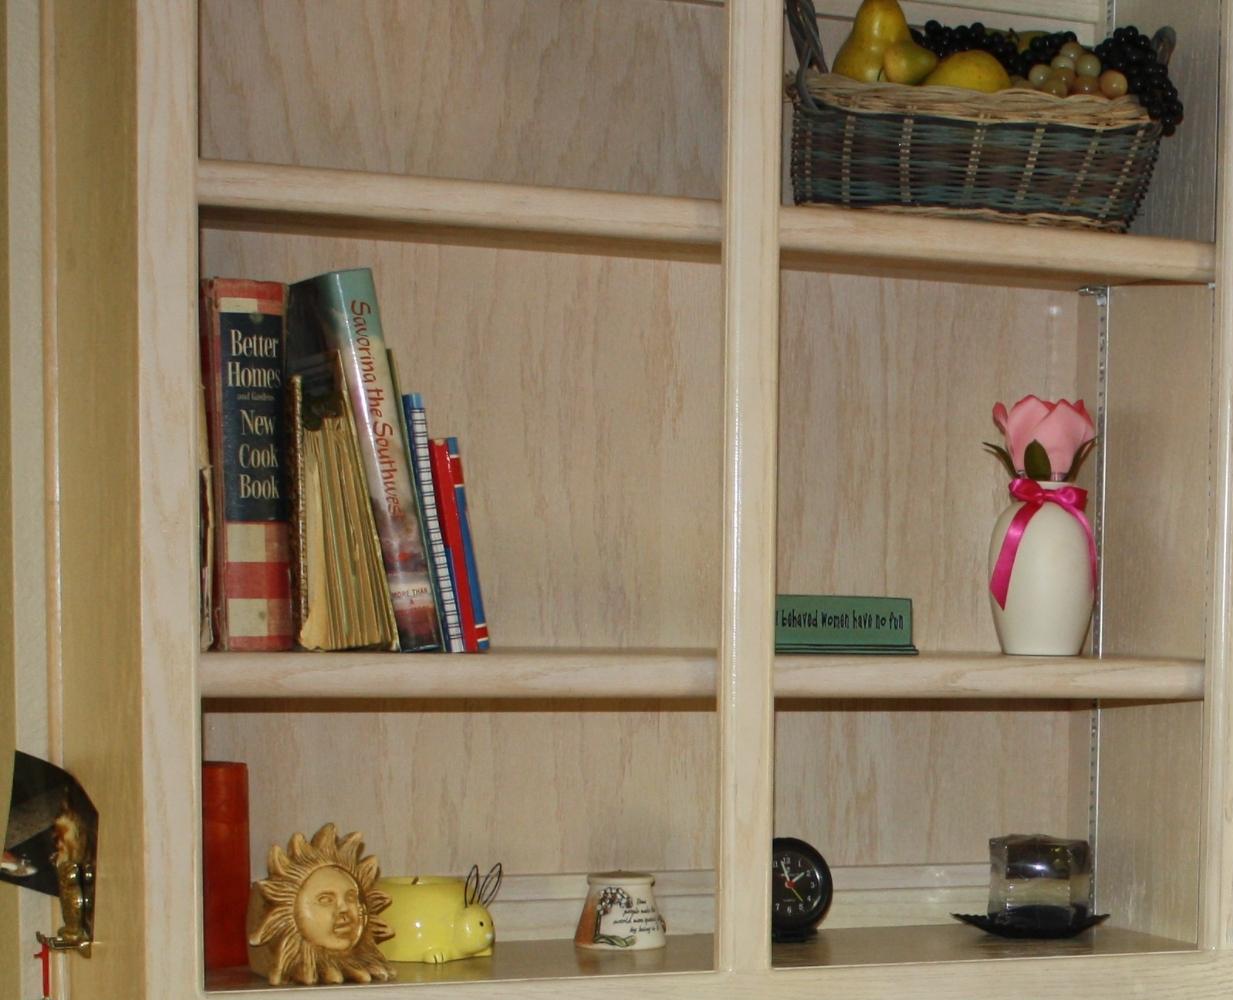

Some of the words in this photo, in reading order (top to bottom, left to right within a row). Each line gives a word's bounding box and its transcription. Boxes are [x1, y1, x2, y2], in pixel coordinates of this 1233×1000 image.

[231, 328, 279, 358] Better
[227, 361, 282, 389] Homes
[367, 387, 385, 418] the
[240, 409, 275, 435] New
[239, 443, 279, 469] Cook
[240, 473, 280, 499] Book
[781, 609, 818, 628] behaved
[852, 609, 872, 629] have
[875, 614, 886, 629] no
[889, 611, 904, 630] fun
